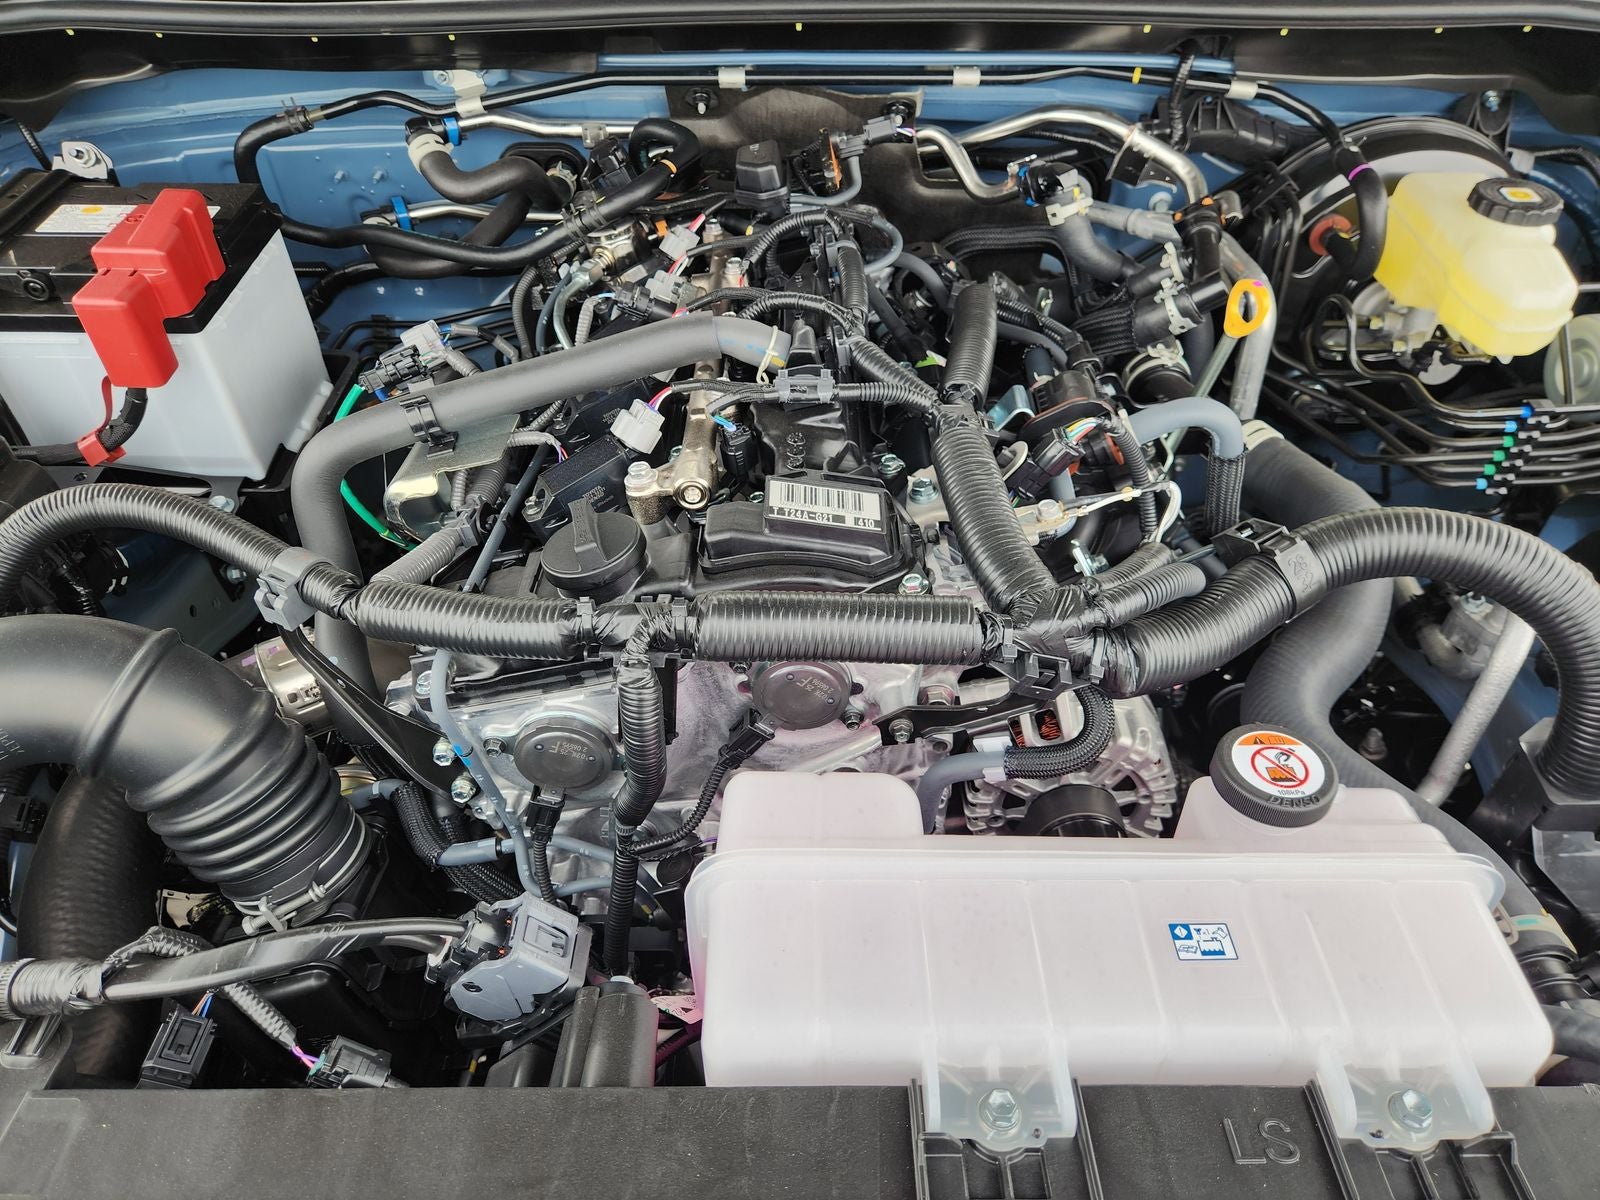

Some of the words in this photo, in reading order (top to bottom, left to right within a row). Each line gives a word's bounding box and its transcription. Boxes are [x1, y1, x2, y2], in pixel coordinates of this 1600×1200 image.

[773, 506, 779, 516] T
[783, 508, 833, 523] T24A-G21
[858, 518, 875, 529] 410
[796, 676, 812, 687] F
[548, 741, 560, 753] F
[1268, 794, 1321, 809] DENSO
[1222, 1118, 1301, 1165] LS
